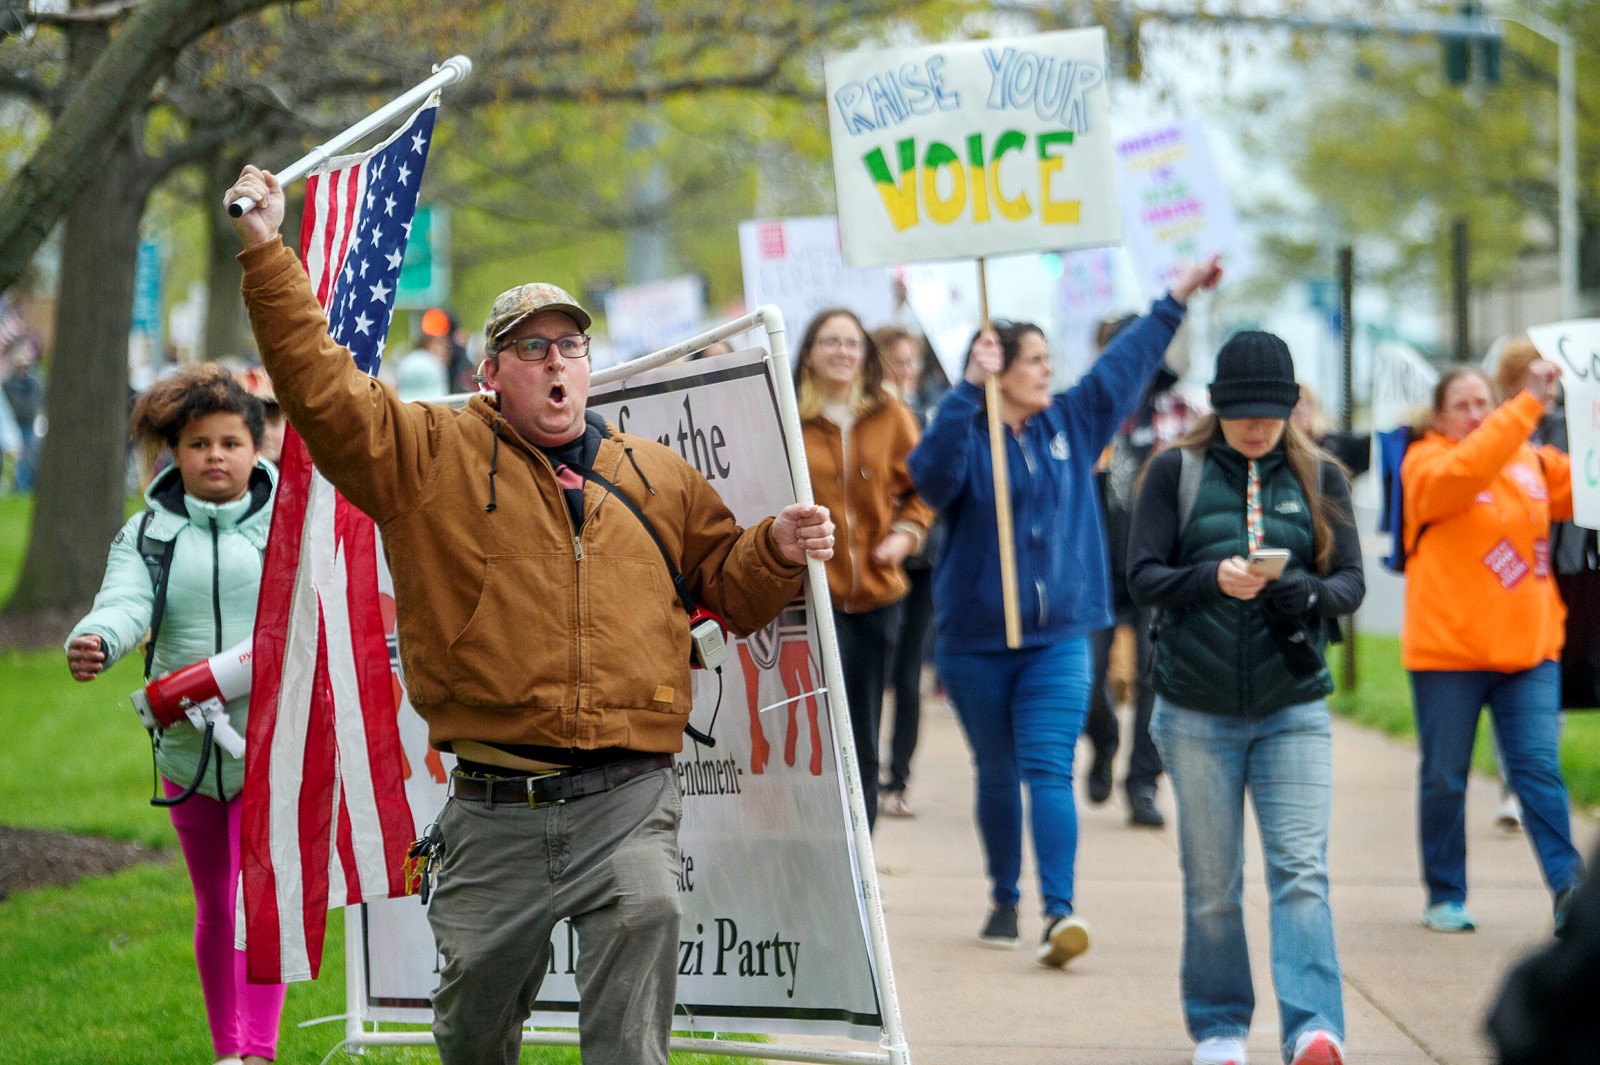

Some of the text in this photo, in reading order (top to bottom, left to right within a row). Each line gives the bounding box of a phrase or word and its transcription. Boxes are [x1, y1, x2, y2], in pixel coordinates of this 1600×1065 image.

[834, 47, 1102, 135] RAISE YOUR
[863, 130, 1080, 232] VOICE
[713, 918, 800, 998] Party
